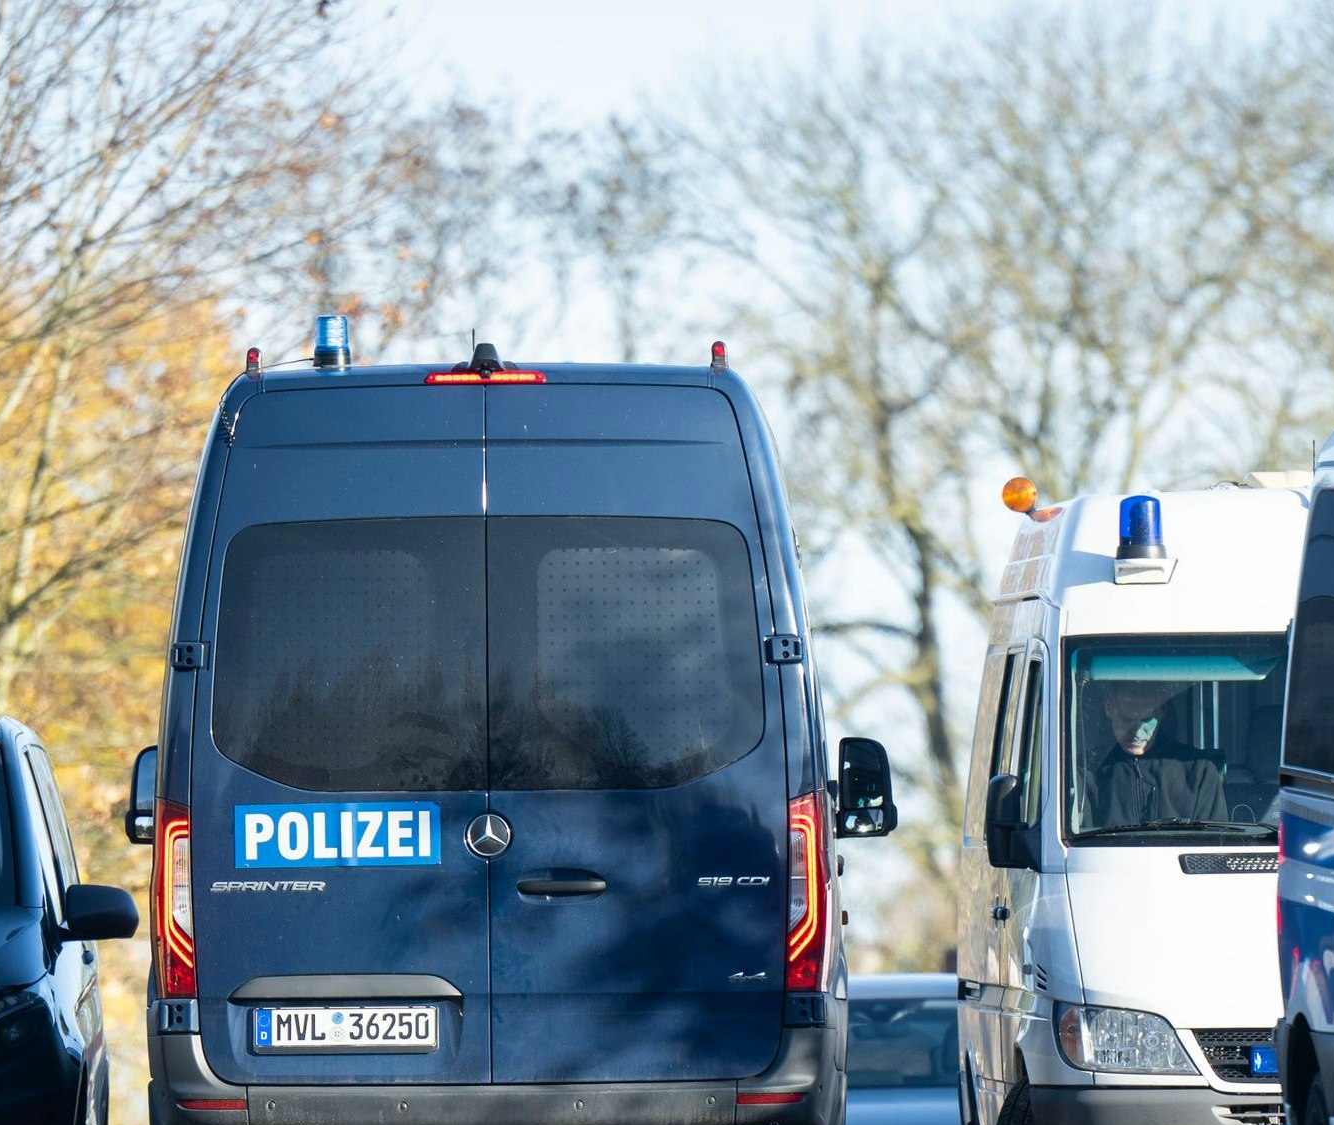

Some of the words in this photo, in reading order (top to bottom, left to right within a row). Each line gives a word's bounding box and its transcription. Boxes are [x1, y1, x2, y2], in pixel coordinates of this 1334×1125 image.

[244, 810, 431, 861] POLIZEI
[209, 880, 327, 893] SPRINTER
[697, 876, 734, 887] 519
[736, 876, 771, 887] CDI
[276, 1014, 326, 1041] MVL
[349, 1013, 430, 1040] 36250
[260, 1031, 268, 1040] D
